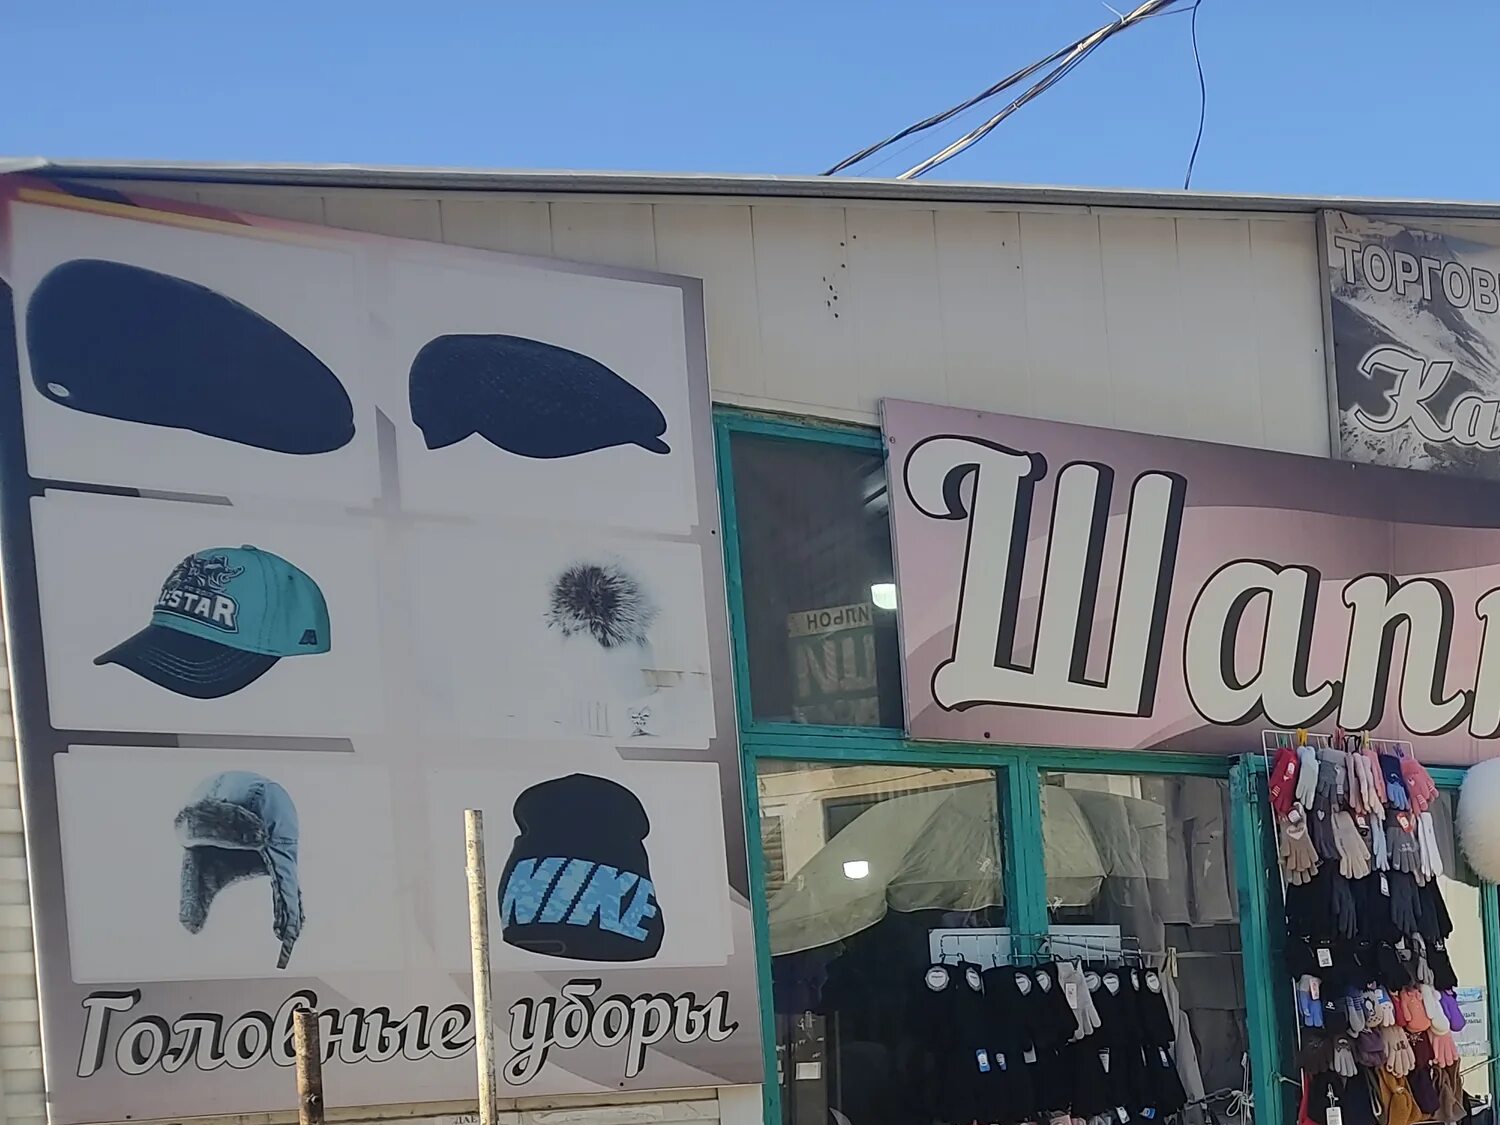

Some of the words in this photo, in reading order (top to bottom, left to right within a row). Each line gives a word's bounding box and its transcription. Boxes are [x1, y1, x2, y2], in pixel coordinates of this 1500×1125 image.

[501, 857, 657, 942] NIKE
[77, 989, 476, 1078] Головные
[503, 978, 740, 1085] уборы
